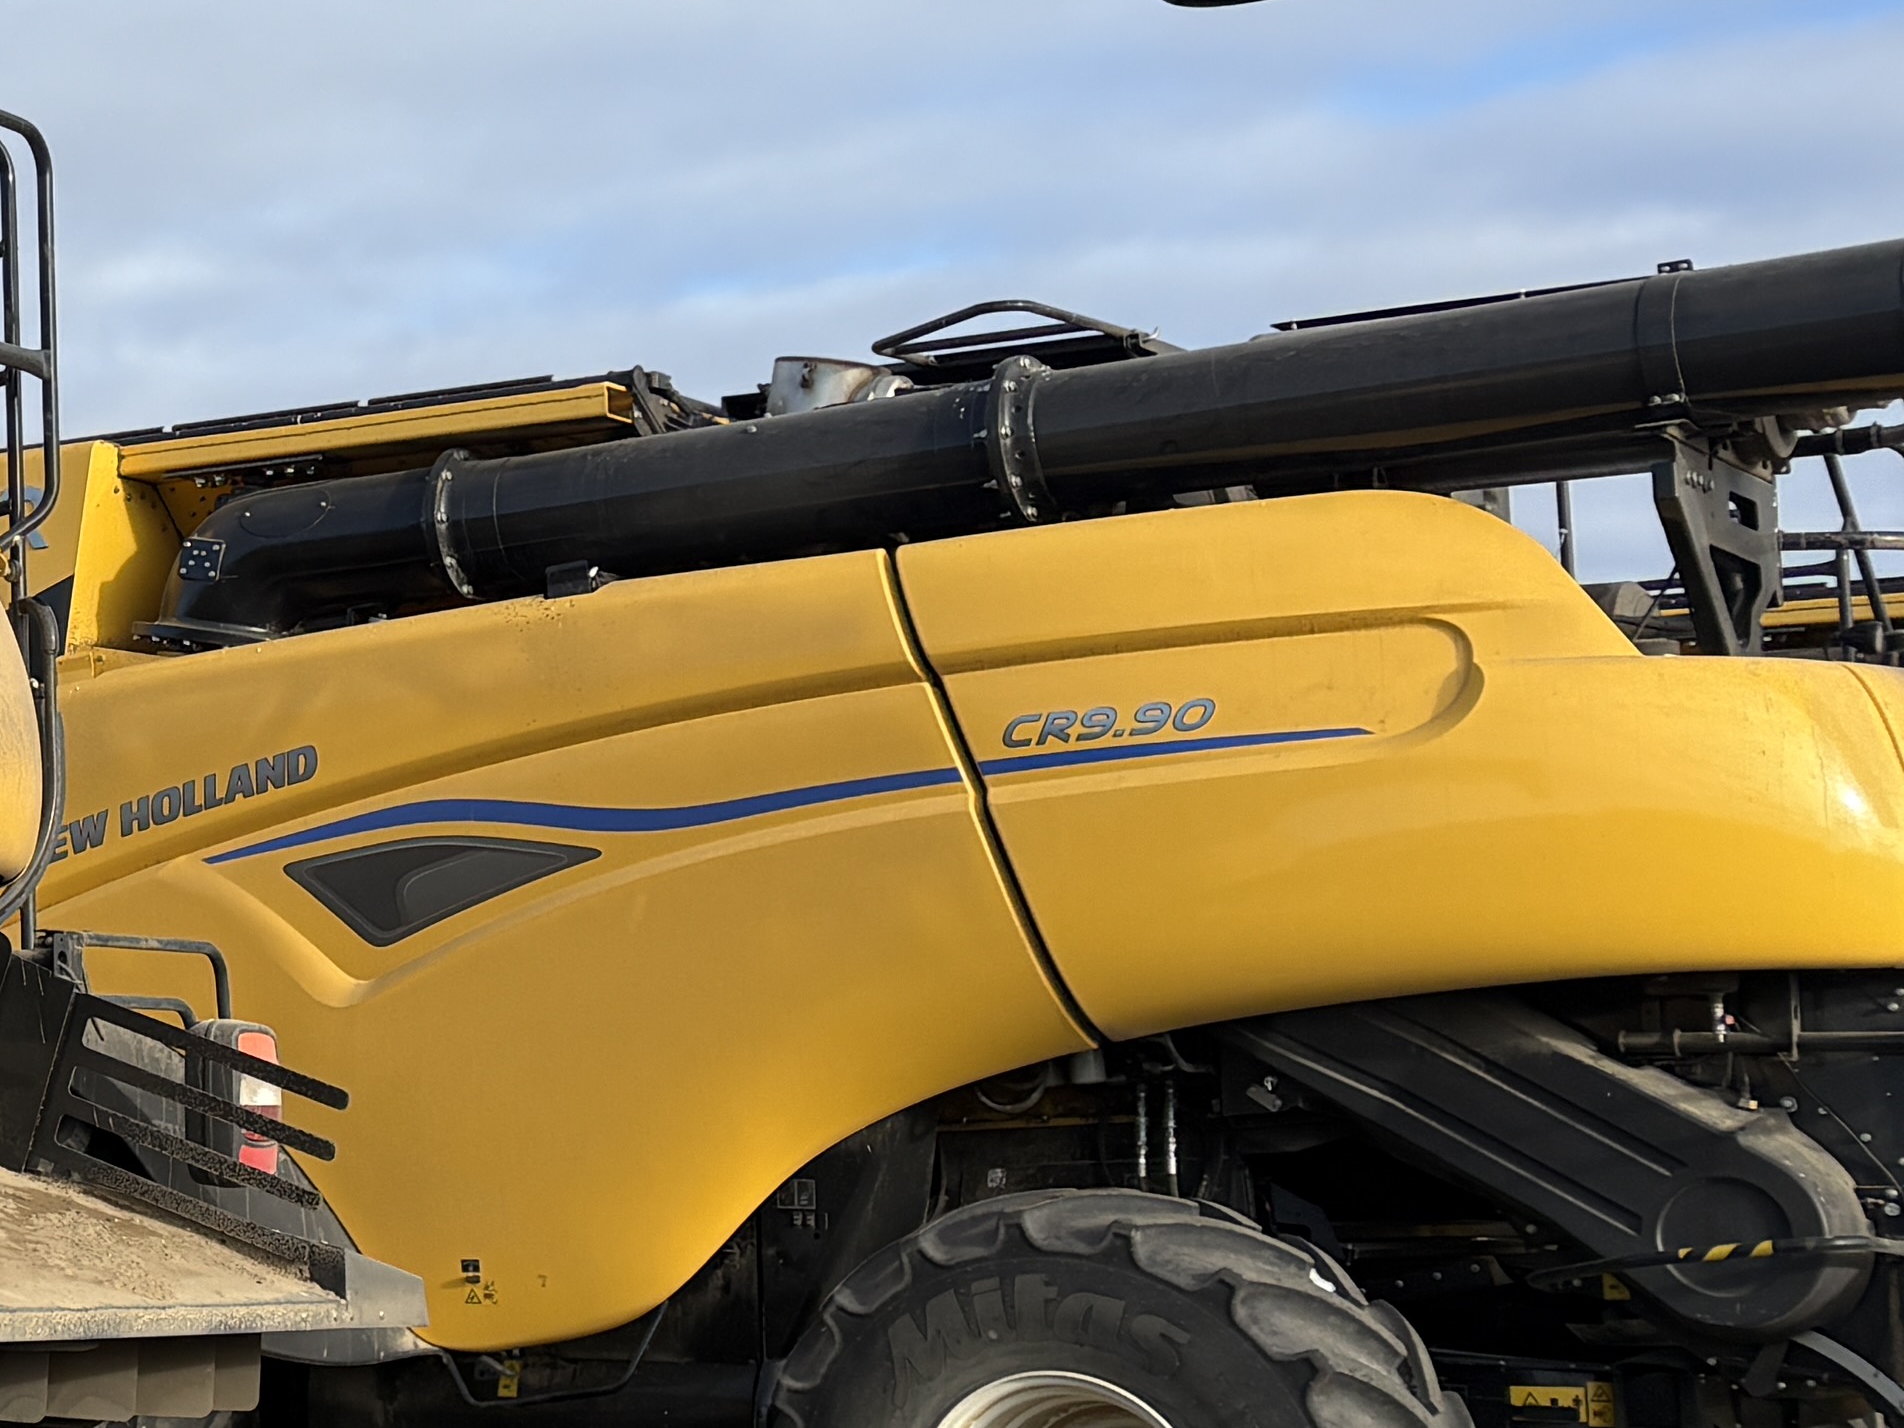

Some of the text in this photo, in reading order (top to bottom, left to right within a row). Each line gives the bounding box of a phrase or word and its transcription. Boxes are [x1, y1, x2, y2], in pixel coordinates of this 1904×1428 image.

[1001, 696, 1217, 750] CR9.90
[48, 743, 320, 867] EW HOLLAND
[886, 1272, 1191, 1410] Mitas
